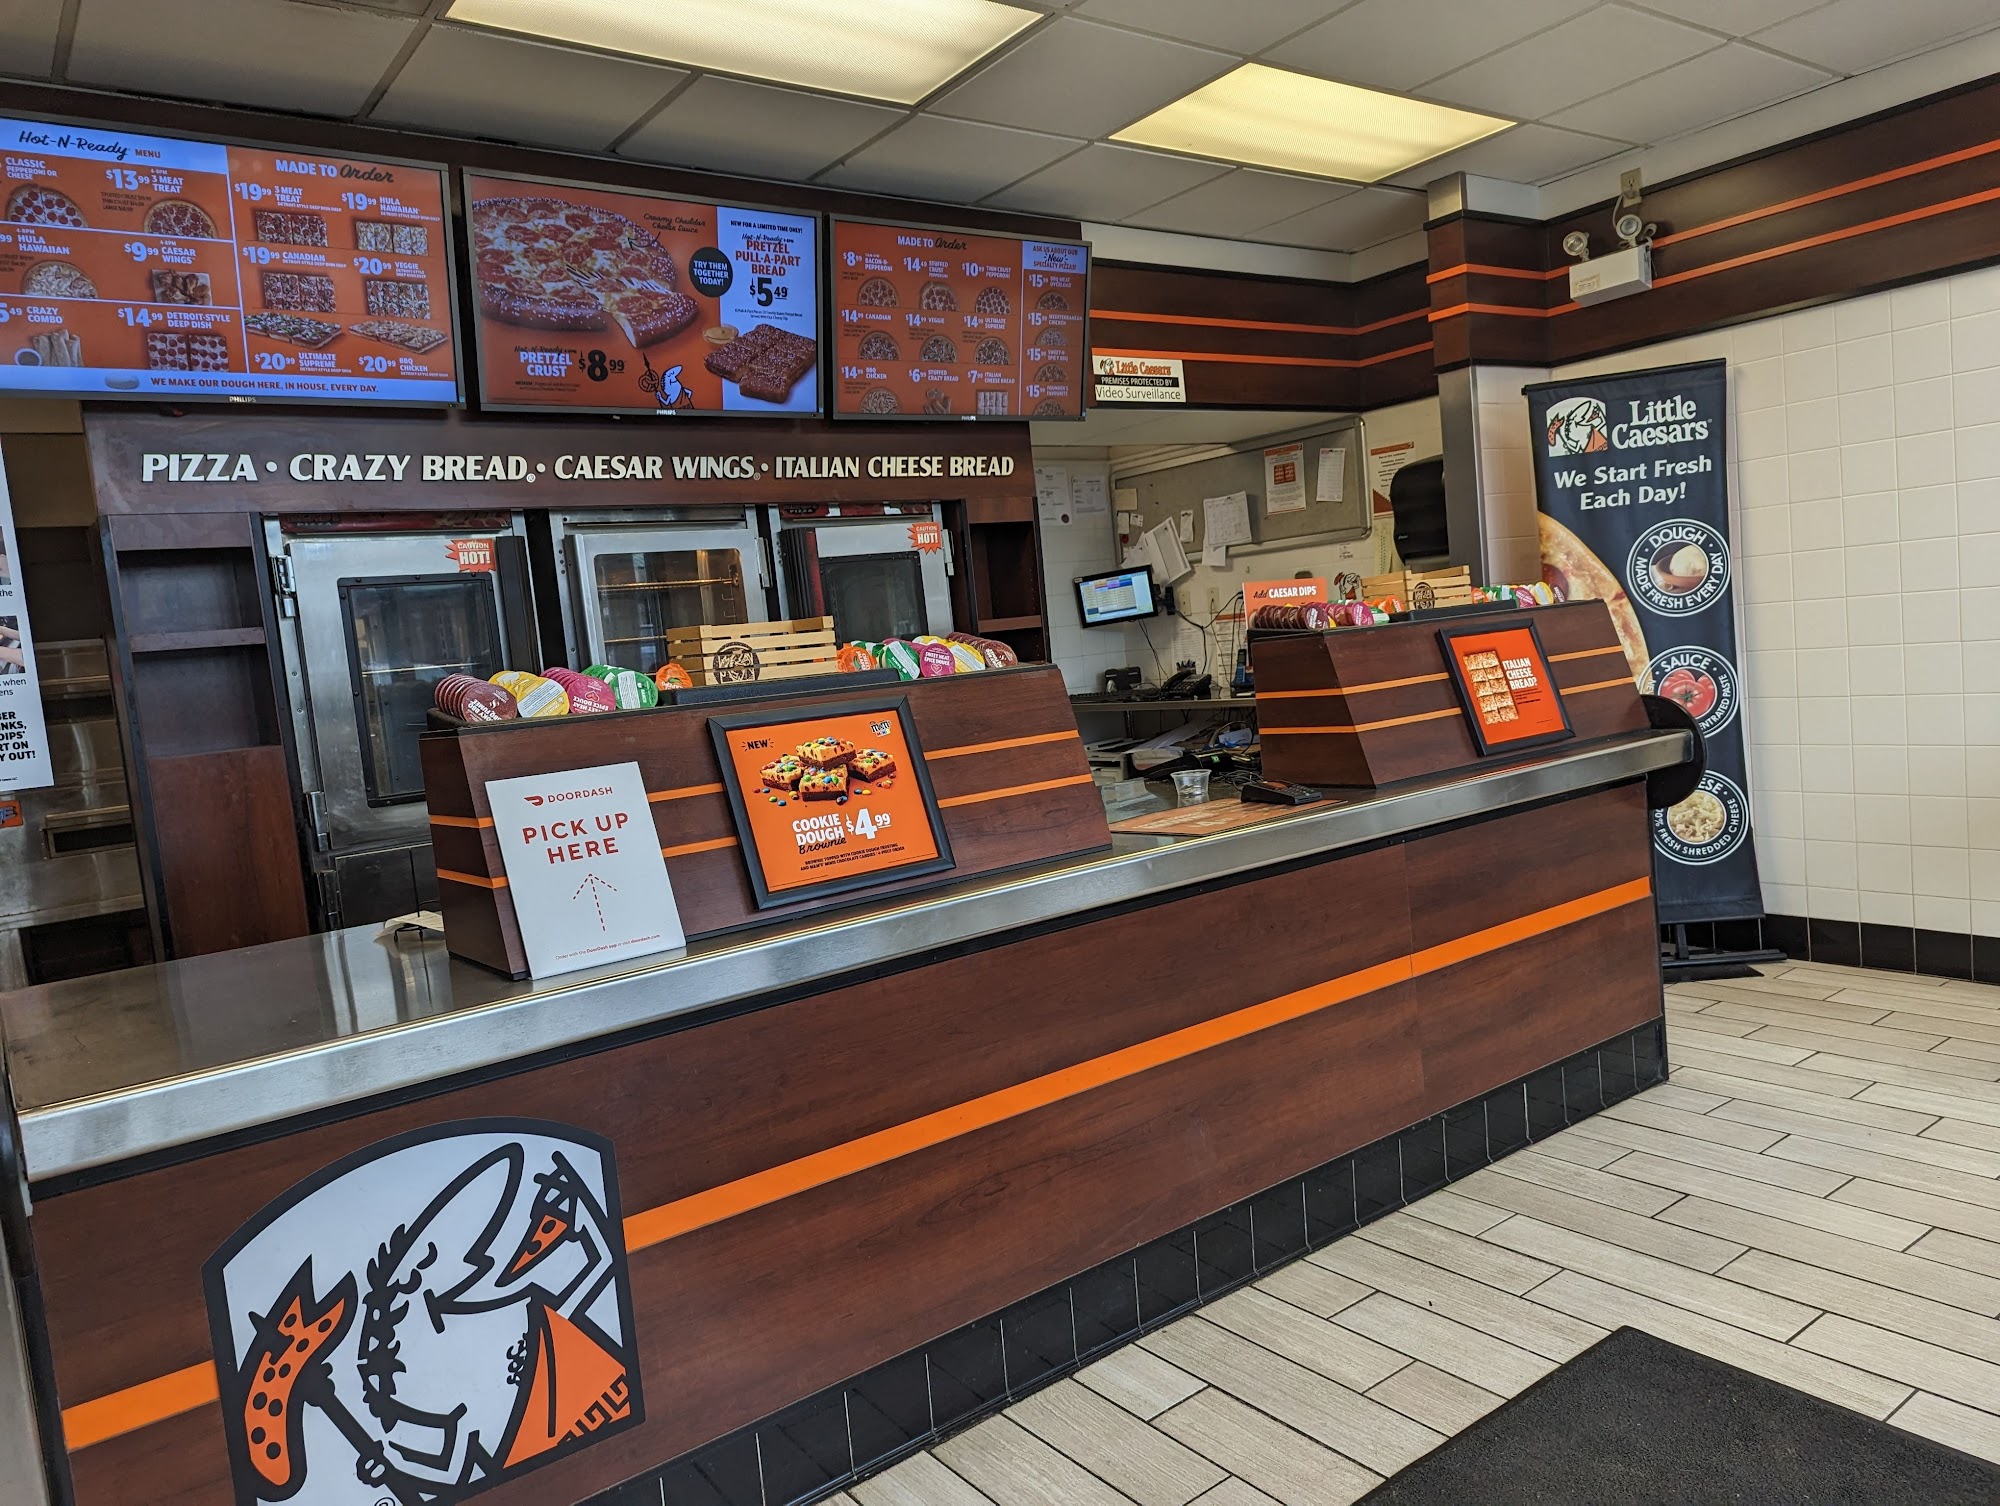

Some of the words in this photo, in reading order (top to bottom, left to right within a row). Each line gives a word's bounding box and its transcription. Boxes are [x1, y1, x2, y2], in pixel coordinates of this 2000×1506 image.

[19, 131, 128, 160] Hot-N-Ready
[135, 149, 161, 159] MENU
[6, 157, 46, 169] CLASSIC
[7, 166, 46, 176] PEPPERONI
[47, 169, 57, 177] OR
[8, 172, 34, 180] CHEESE
[276, 160, 317, 175] MADE
[319, 165, 338, 178] TO
[340, 165, 394, 183] Order
[159, 176, 184, 186] MEAT
[153, 184, 182, 194] TREAT
[281, 187, 303, 196] MEAT
[276, 195, 301, 203] TREAT
[380, 197, 400, 206] HULA
[644, 213, 673, 225] Creamy
[743, 221, 753, 229] FOR
[757, 223, 777, 231] LIMITED
[789, 226, 803, 234] ONLY!
[18, 235, 45, 245] HULA
[898, 236, 921, 247] MADE
[923, 238, 934, 248] TO
[935, 238, 967, 250] Order
[19, 244, 70, 255] HAWAIIAN
[162, 247, 196, 257] CAESAR
[747, 240, 790, 254] PRETZEL
[163, 256, 192, 265] WINGS
[283, 252, 326, 262] CANADIAN
[736, 251, 801, 267] PULL-A-PART
[1047, 253, 1064, 263] New
[395, 262, 419, 270] VEGGIE
[694, 260, 708, 270] TRY
[708, 262, 728, 271] THEM
[752, 264, 786, 277] BREAD
[693, 268, 729, 279] TOGETHER
[699, 277, 724, 286] TODAY!
[26, 306, 59, 316] CRAZY
[866, 313, 892, 321] CANADIAN
[28, 314, 62, 324] COMBO
[168, 320, 190, 328] DEEP
[191, 321, 212, 329] DISH
[299, 353, 337, 361] ULTIMATE
[520, 352, 573, 366] PRETZEL
[299, 360, 336, 368] SUPREME
[400, 364, 428, 372] CHICKEN
[1116, 361, 1139, 375] Little
[1140, 362, 1172, 376] Caesars
[527, 365, 567, 378] CRUST
[151, 378, 167, 387] WE
[168, 378, 196, 387] MAKE
[199, 379, 219, 388] OUR
[221, 380, 255, 390] DOUGH
[258, 382, 283, 391] HERE,
[285, 382, 295, 390] IN
[297, 383, 329, 392] HOUSE,
[331, 383, 358, 392] EVERY
[360, 385, 379, 393] DAY.
[1101, 377, 1130, 385] PREMISES
[1130, 378, 1165, 387] PROTECTED
[1165, 379, 1173, 387] BY
[1095, 387, 1124, 399] Video
[1126, 388, 1181, 400] Surveillance
[1629, 394, 1697, 427] Little
[1612, 419, 1709, 450] Caesars
[142, 453, 258, 482] PIZZA
[290, 454, 412, 482] CRAZY
[422, 455, 528, 482] BREAD
[554, 455, 663, 481] CAESAR
[671, 456, 756, 480] WINGS
[775, 456, 860, 479] ITALIAN
[868, 456, 943, 479] CHEESE
[950, 456, 1015, 478] BREAD
[1554, 470, 1587, 489] We
[1593, 463, 1647, 485] Start
[1654, 455, 1713, 478] Fresh
[1580, 486, 1631, 511] Each
[1638, 482, 1687, 505] Day!
[917, 533, 939, 544] HOT!
[1649, 527, 1707, 549] DOUGH
[457, 541, 490, 550] CAUTION
[459, 551, 491, 565] HOT!
[1635, 557, 1652, 592] MADE
[1646, 589, 1683, 609] FRESH
[1685, 575, 1720, 607] EVERY
[1709, 553, 1724, 574] DAY
[1253, 590, 1268, 599] Add
[1268, 587, 1299, 599] CAESAR
[1299, 586, 1317, 596] DIPS
[1502, 657, 1532, 671] ITALIAN
[1661, 654, 1712, 674] SAUCE
[1506, 668, 1534, 680] CHEESE
[1509, 677, 1538, 691] BREAD?
[1717, 674, 1731, 698] PASTE
[13, 741, 29, 751] ON
[747, 739, 768, 751] NEW
[9, 751, 36, 761] OUT!
[548, 786, 614, 803] DOORDASH
[522, 818, 588, 845] PICK
[595, 812, 629, 832] UP
[792, 813, 842, 833] COOKIE
[1658, 828, 1682, 851] FRESH
[1682, 835, 1732, 857] SHREDDED
[1726, 798, 1740, 833] CHEESE
[796, 826, 846, 847] DOUGH
[547, 837, 619, 865] HERE
[798, 837, 847, 855] Brownie
[824, 855, 840, 863] TOPPED
[840, 852, 851, 860] WITH
[851, 850, 866, 858] COOKIE
[866, 847, 880, 855] DOUGH
[837, 856, 859, 865] CHOCOLATE
[587, 945, 609, 954] DoorDash
[631, 934, 661, 944] doordash.com
